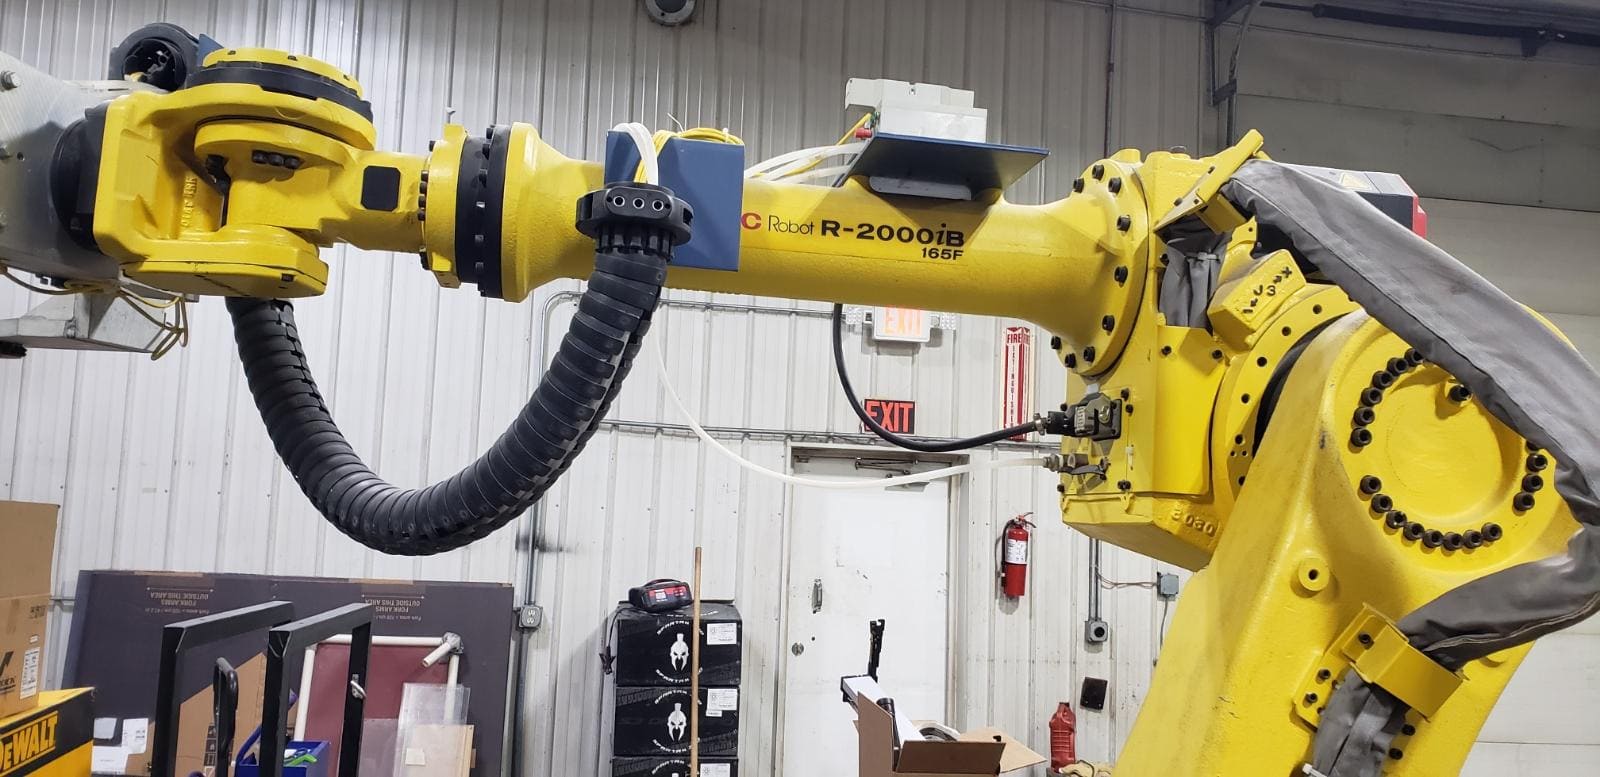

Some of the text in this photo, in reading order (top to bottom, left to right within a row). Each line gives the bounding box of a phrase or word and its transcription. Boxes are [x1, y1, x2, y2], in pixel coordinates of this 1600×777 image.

[768, 215, 815, 235] Robot
[821, 219, 965, 248] R-2000iB
[922, 247, 964, 261] 165F
[1007, 333, 1021, 344] FIRE
[866, 401, 913, 432] EXIT
